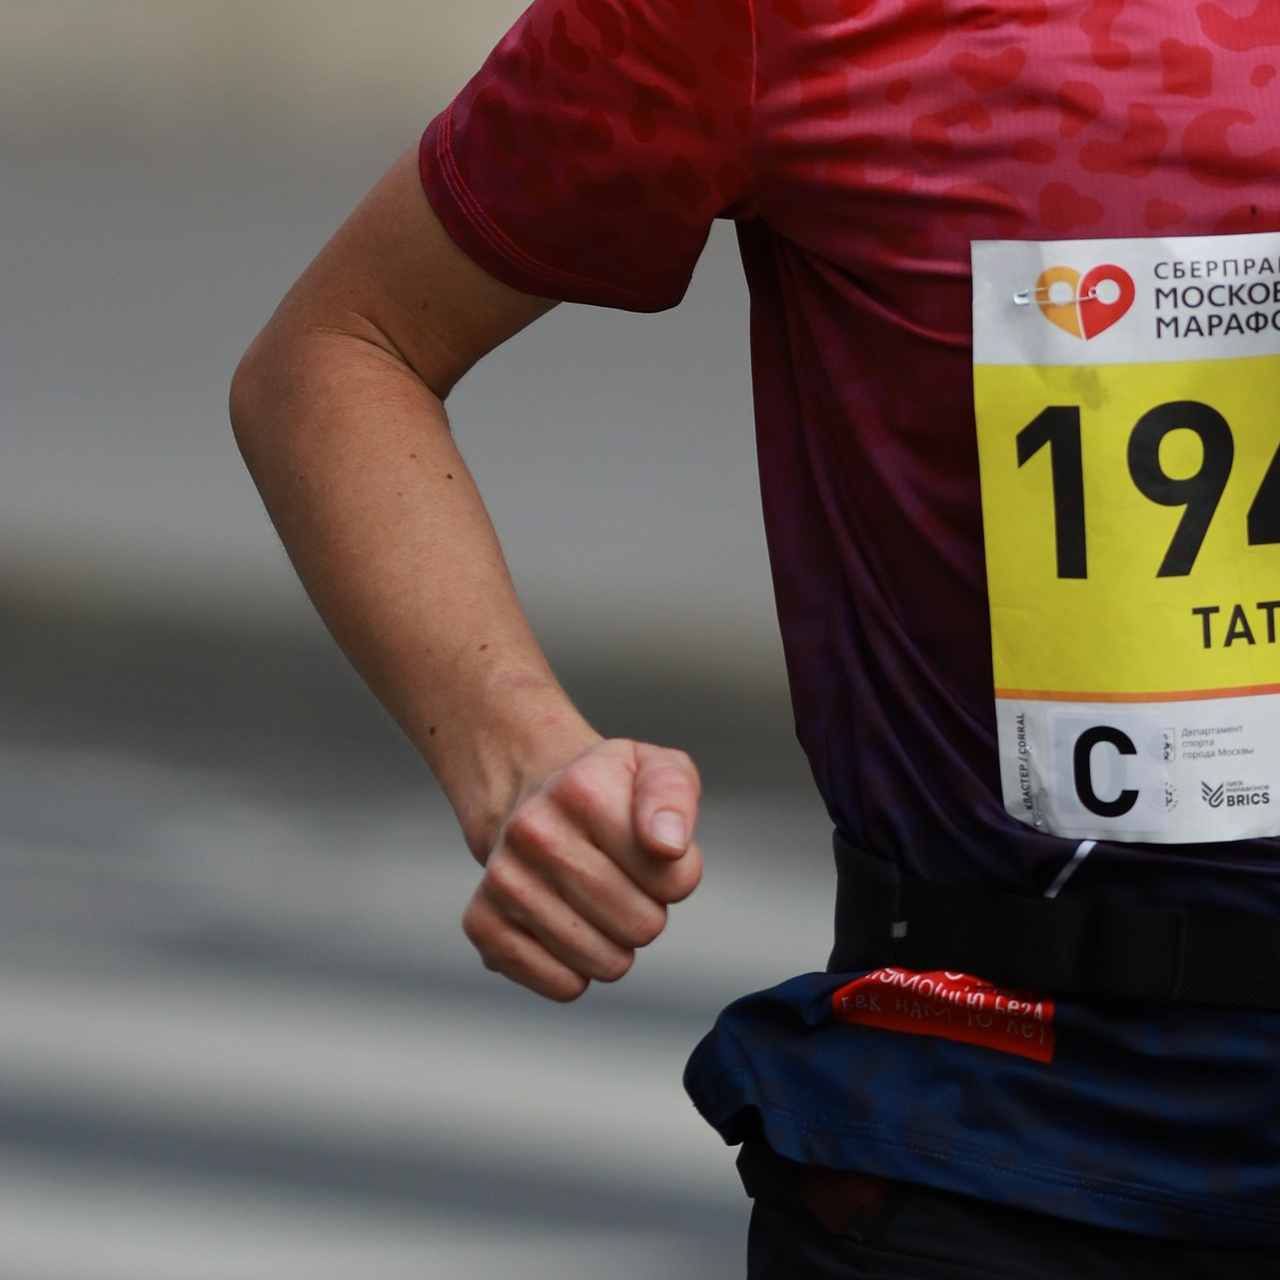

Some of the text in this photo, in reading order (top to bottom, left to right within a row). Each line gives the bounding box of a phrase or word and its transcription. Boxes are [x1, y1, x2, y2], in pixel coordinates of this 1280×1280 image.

[1181, 725, 1243, 738] Департамент
[1182, 739, 1215, 749] спорта
[1182, 750, 1215, 760] города
[1226, 792, 1270, 807] BRICS
